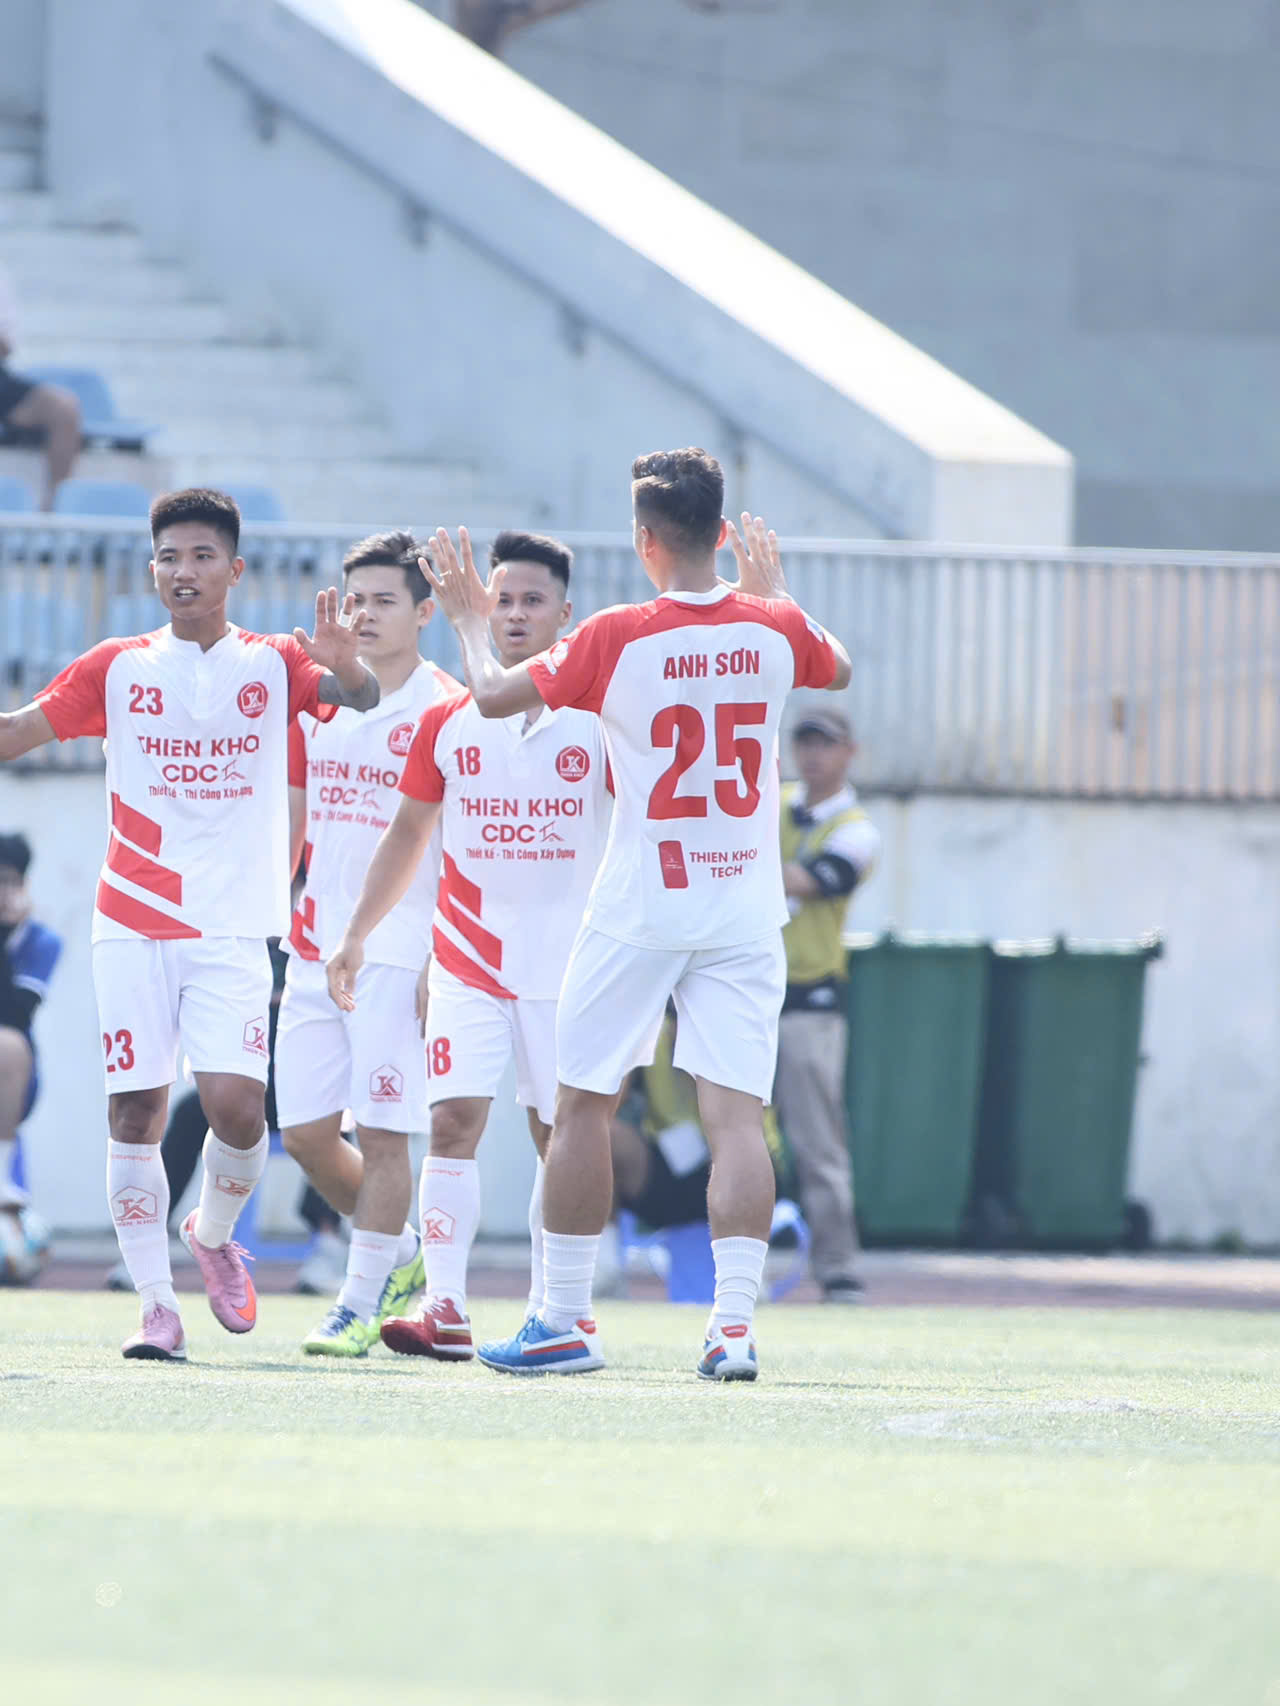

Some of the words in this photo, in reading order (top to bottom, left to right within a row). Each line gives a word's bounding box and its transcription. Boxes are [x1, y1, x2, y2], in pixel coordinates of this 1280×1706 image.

[663, 651, 708, 680] ANH
[715, 647, 760, 676] SƠN
[129, 684, 164, 716] 23
[210, 734, 260, 757] KHO
[453, 746, 481, 776] 18
[646, 701, 769, 821] 25
[161, 763, 219, 783] CDC
[307, 760, 350, 780] HIEN
[356, 764, 399, 788] KHO
[320, 785, 358, 806] CDC
[459, 796, 519, 818] THIEN
[528, 796, 584, 818] KHOI
[481, 823, 537, 844] CDC
[689, 851, 728, 864] THIEN
[710, 864, 743, 879] TECH
[103, 1028, 135, 1074] 23
